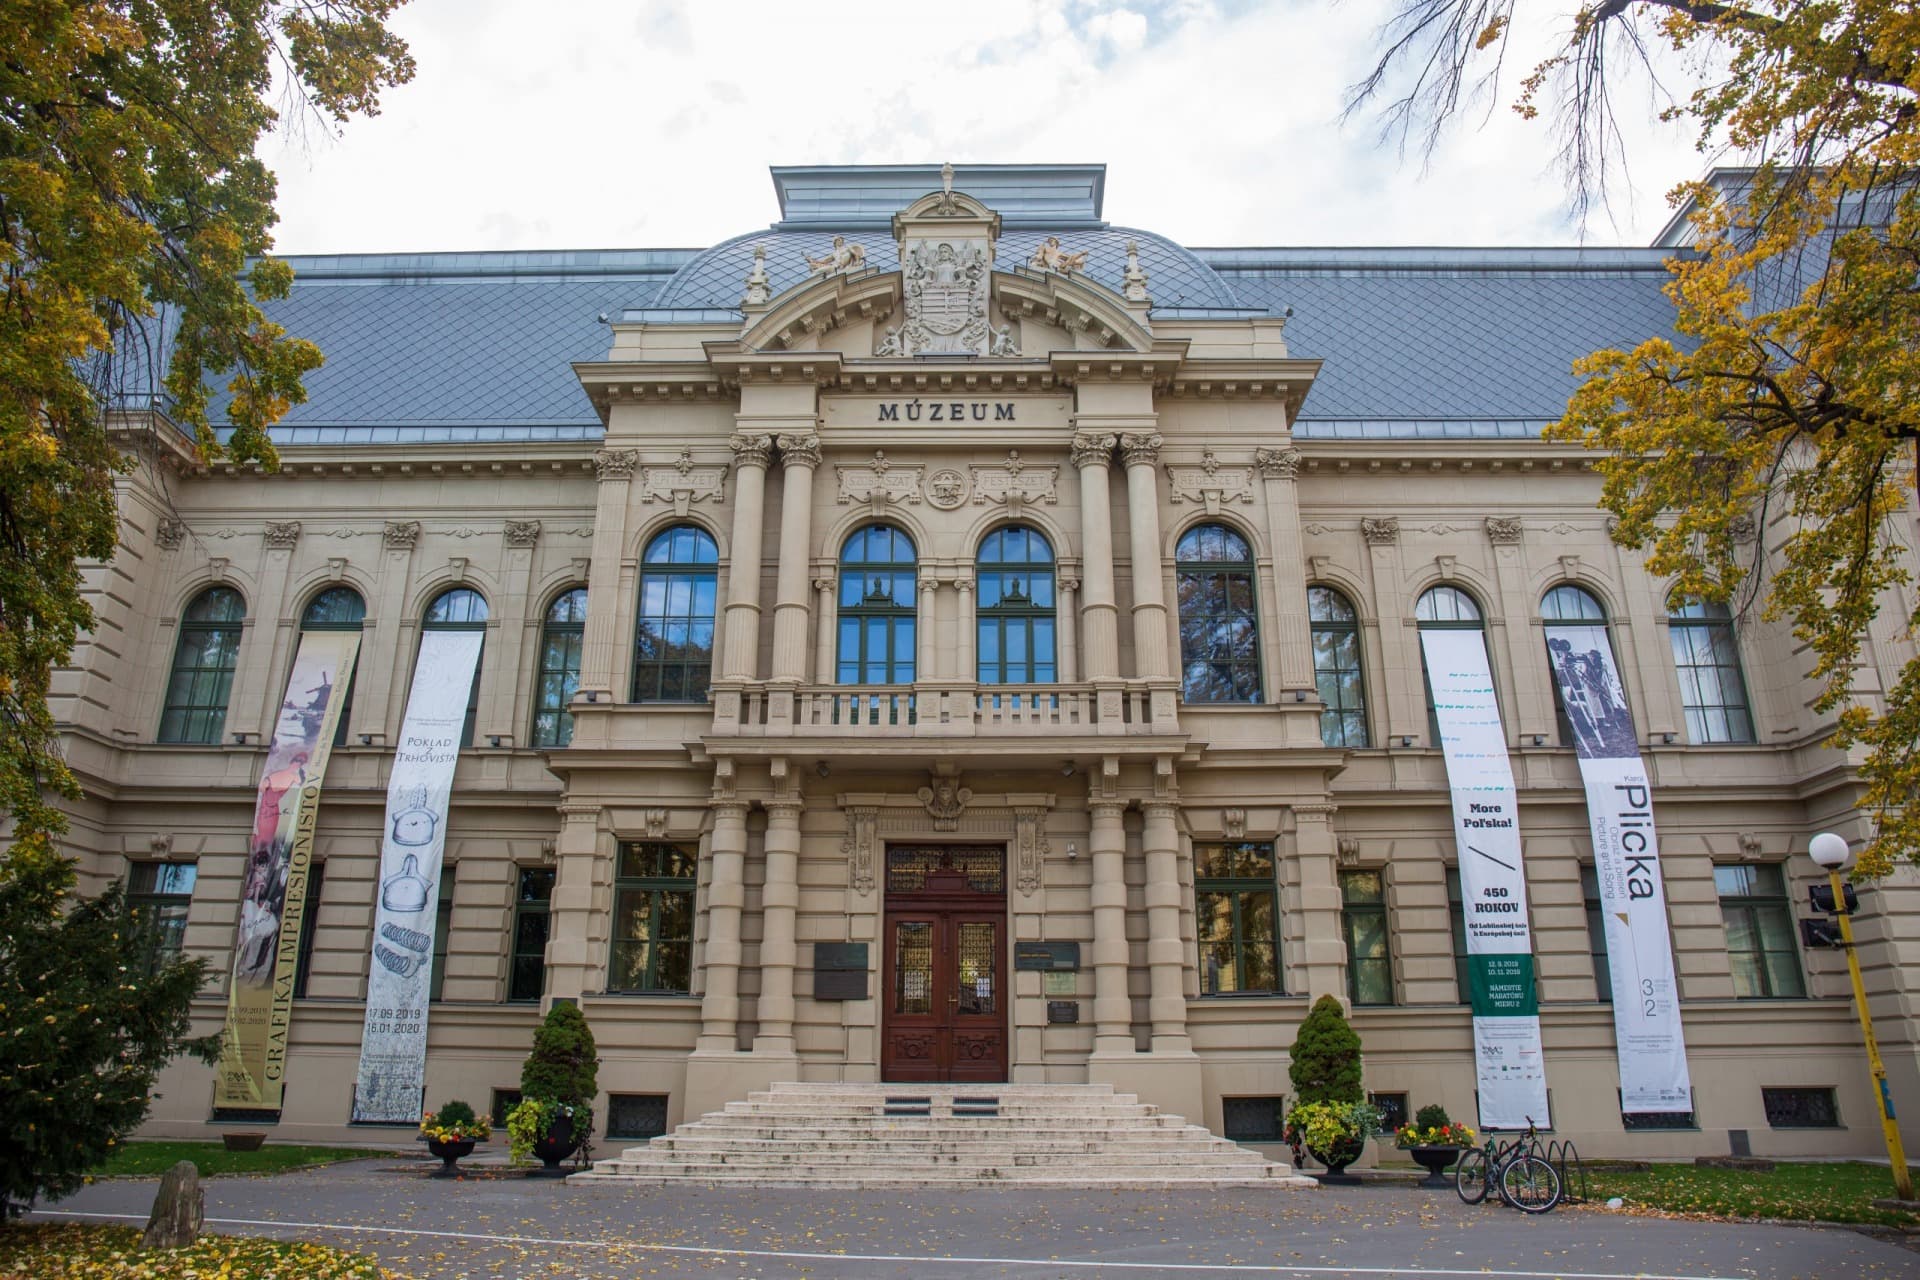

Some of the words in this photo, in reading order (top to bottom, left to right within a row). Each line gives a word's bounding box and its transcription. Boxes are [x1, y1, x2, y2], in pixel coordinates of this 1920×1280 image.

[878, 398, 1015, 421] MÚZEUM
[407, 737, 452, 747] POKLAD
[1470, 803, 1502, 813] More
[1463, 818, 1512, 828] Poľska!
[1597, 816, 1608, 850] Picture
[1614, 785, 1657, 901] Plicka
[1601, 851, 1611, 871] and
[1483, 887, 1508, 898] 450
[1605, 873, 1615, 899] Song
[1475, 902, 1519, 913] ROKOV
[265, 974, 292, 1081] GRAFIKA
[279, 774, 321, 963] IMPRESIONISTOV
[1642, 978, 1654, 996] 3
[369, 1008, 421, 1020] 17.09.2019
[1645, 1000, 1656, 1016] 2
[367, 1023, 420, 1034] 16.01.2020
